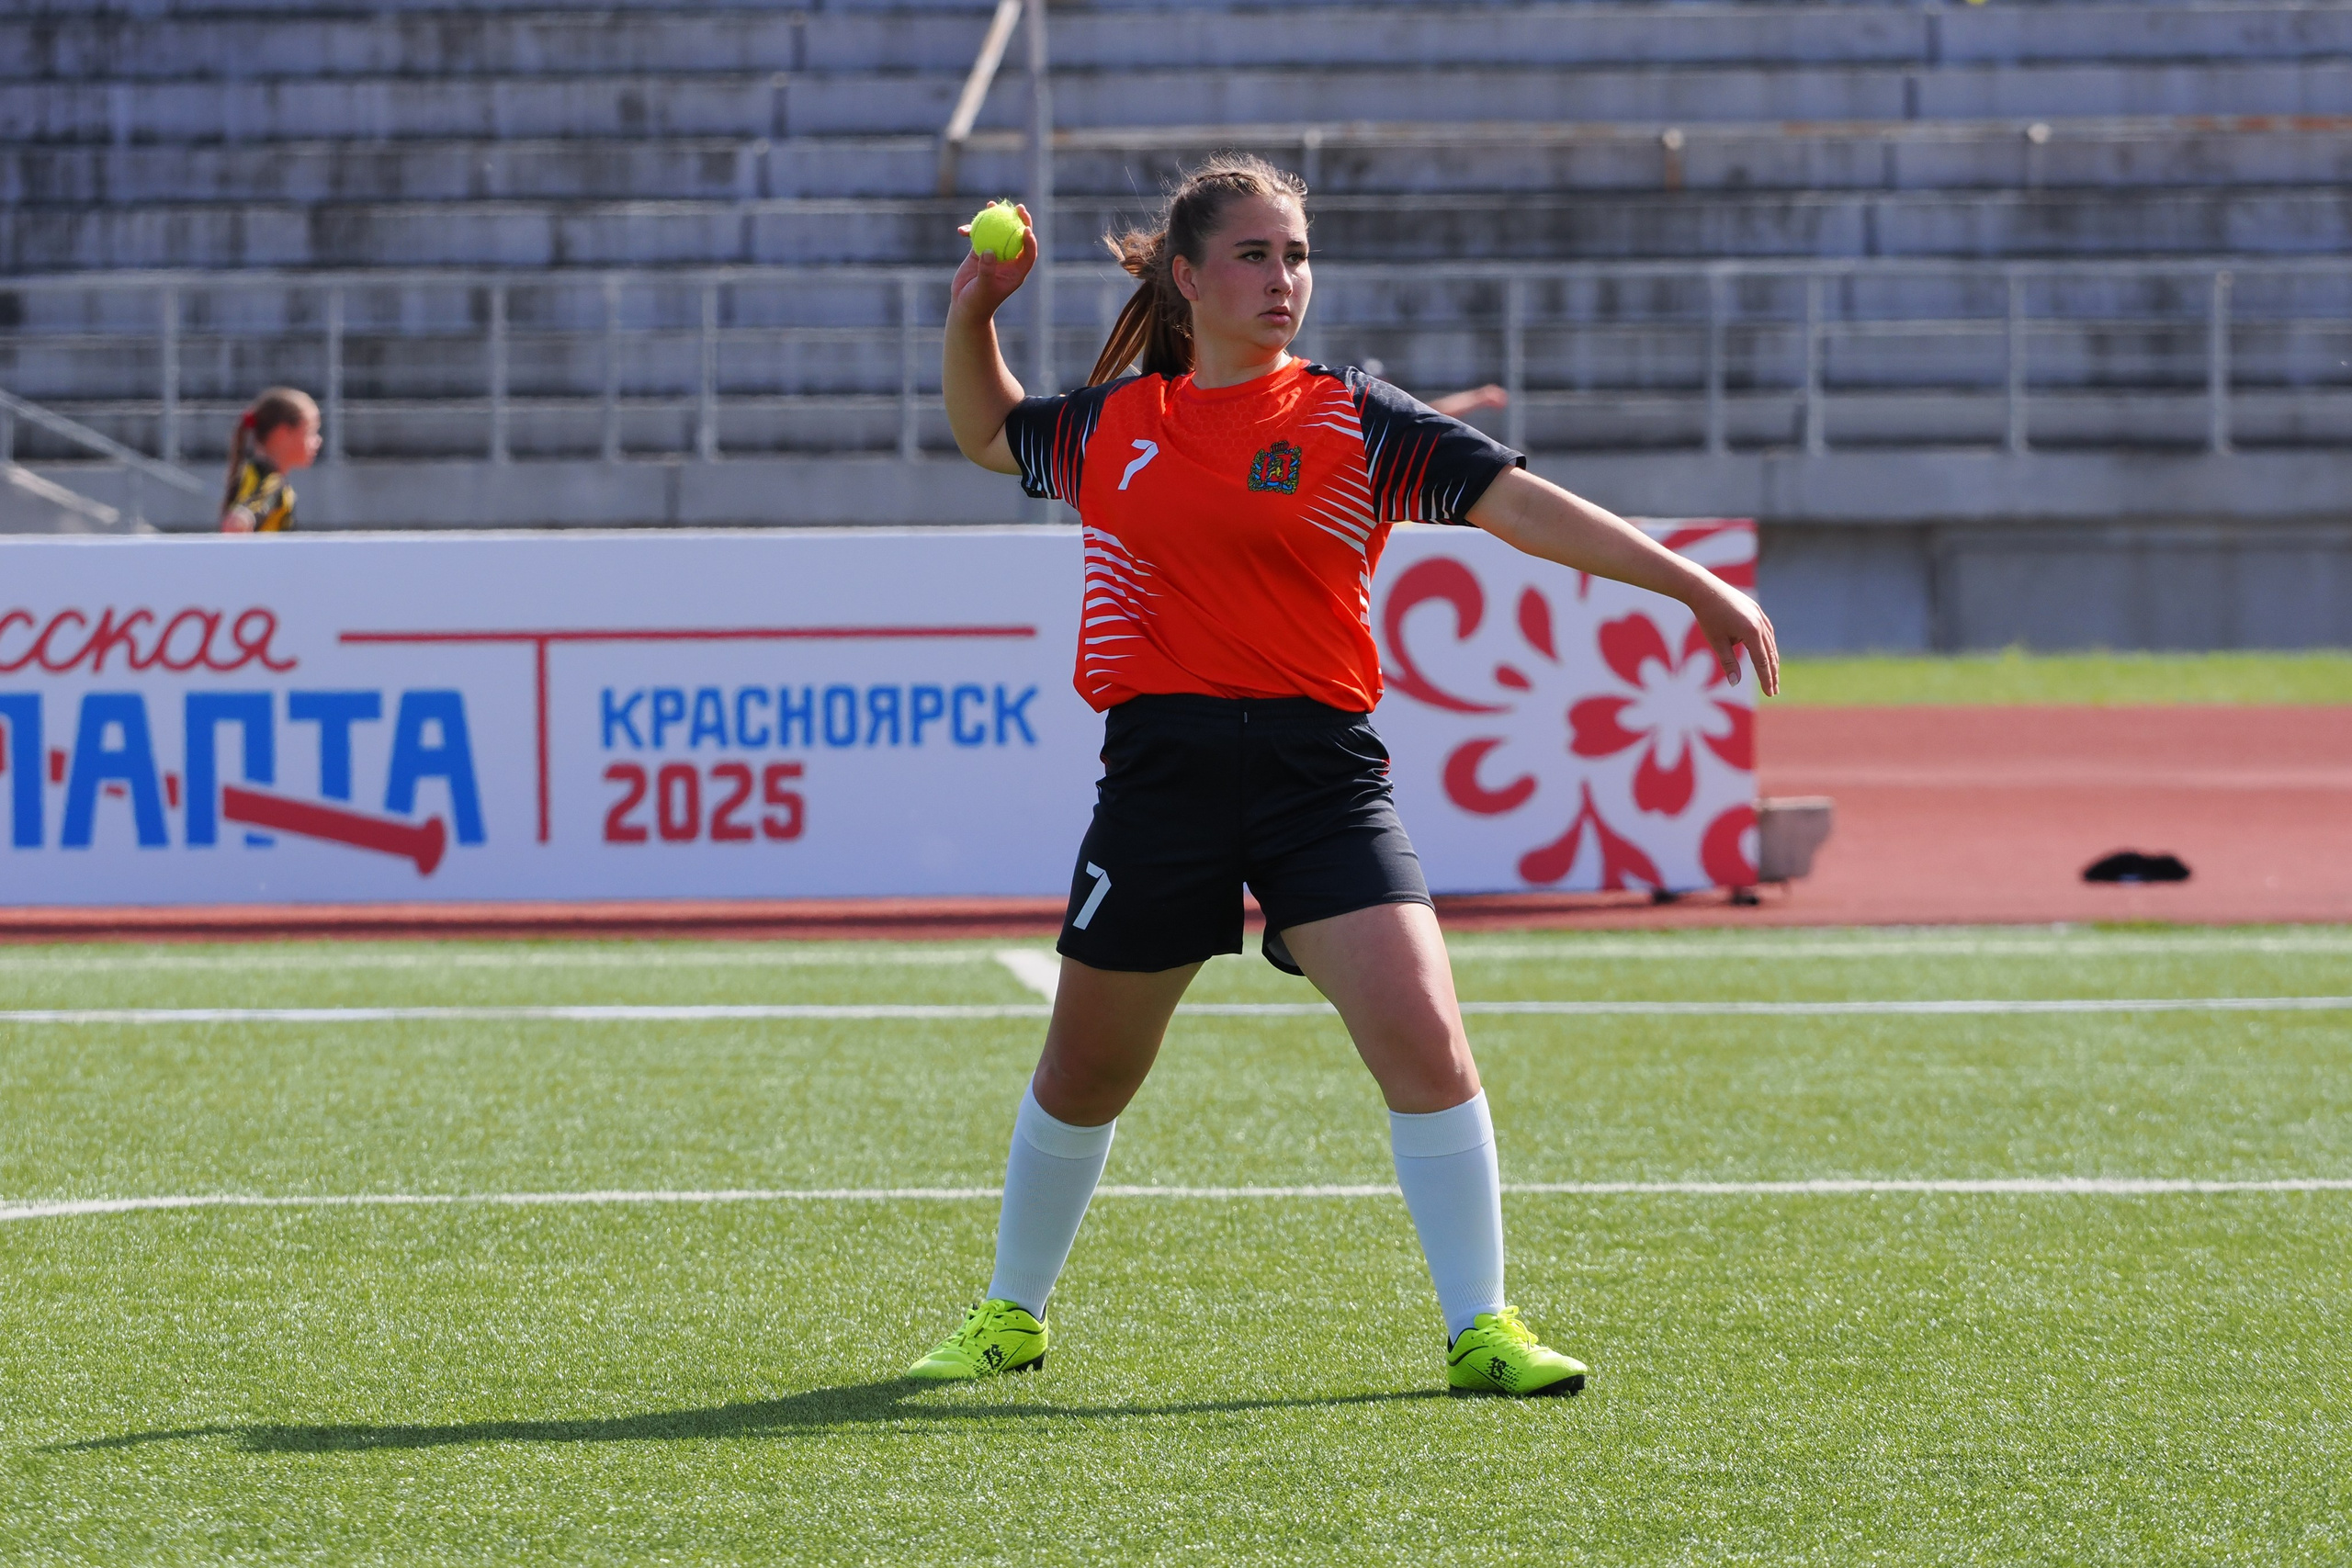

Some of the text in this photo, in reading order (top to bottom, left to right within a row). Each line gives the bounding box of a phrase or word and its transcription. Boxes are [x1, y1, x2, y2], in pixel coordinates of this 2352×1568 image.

[1117, 438, 1159, 491] 7
[600, 683, 1039, 750] КРАСНОЯРСК
[603, 761, 806, 843] 2025
[1072, 861, 1112, 931] 7
